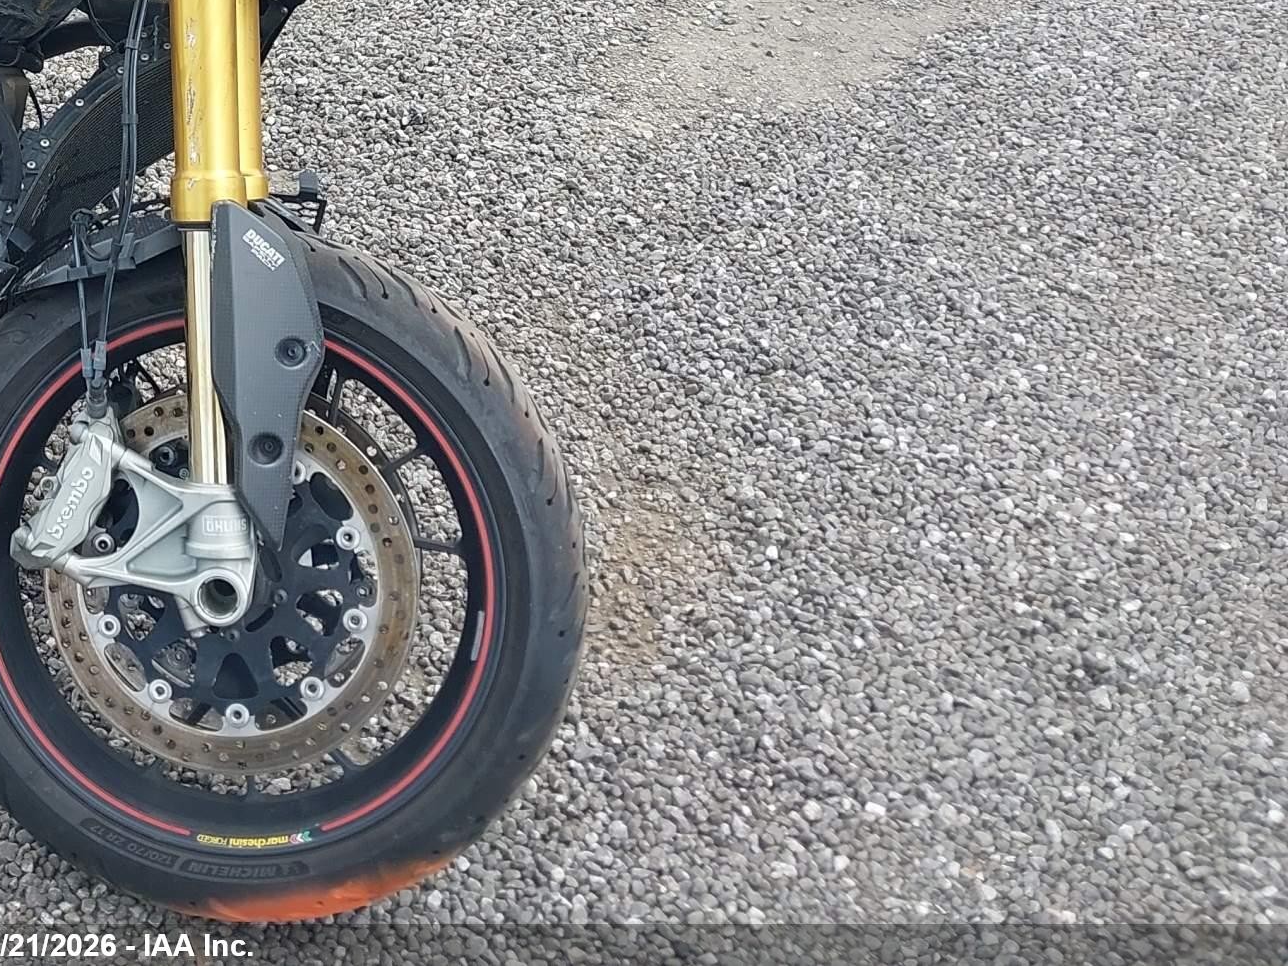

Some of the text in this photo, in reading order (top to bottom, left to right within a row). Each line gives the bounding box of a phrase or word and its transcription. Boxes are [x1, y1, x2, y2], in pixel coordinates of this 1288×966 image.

[245, 228, 286, 268] DUCATI
[47, 466, 95, 541] brembo
[196, 833, 289, 849] marchesini FORGED
[128, 842, 173, 865] 120/70
[189, 860, 277, 878] MICHELIN
